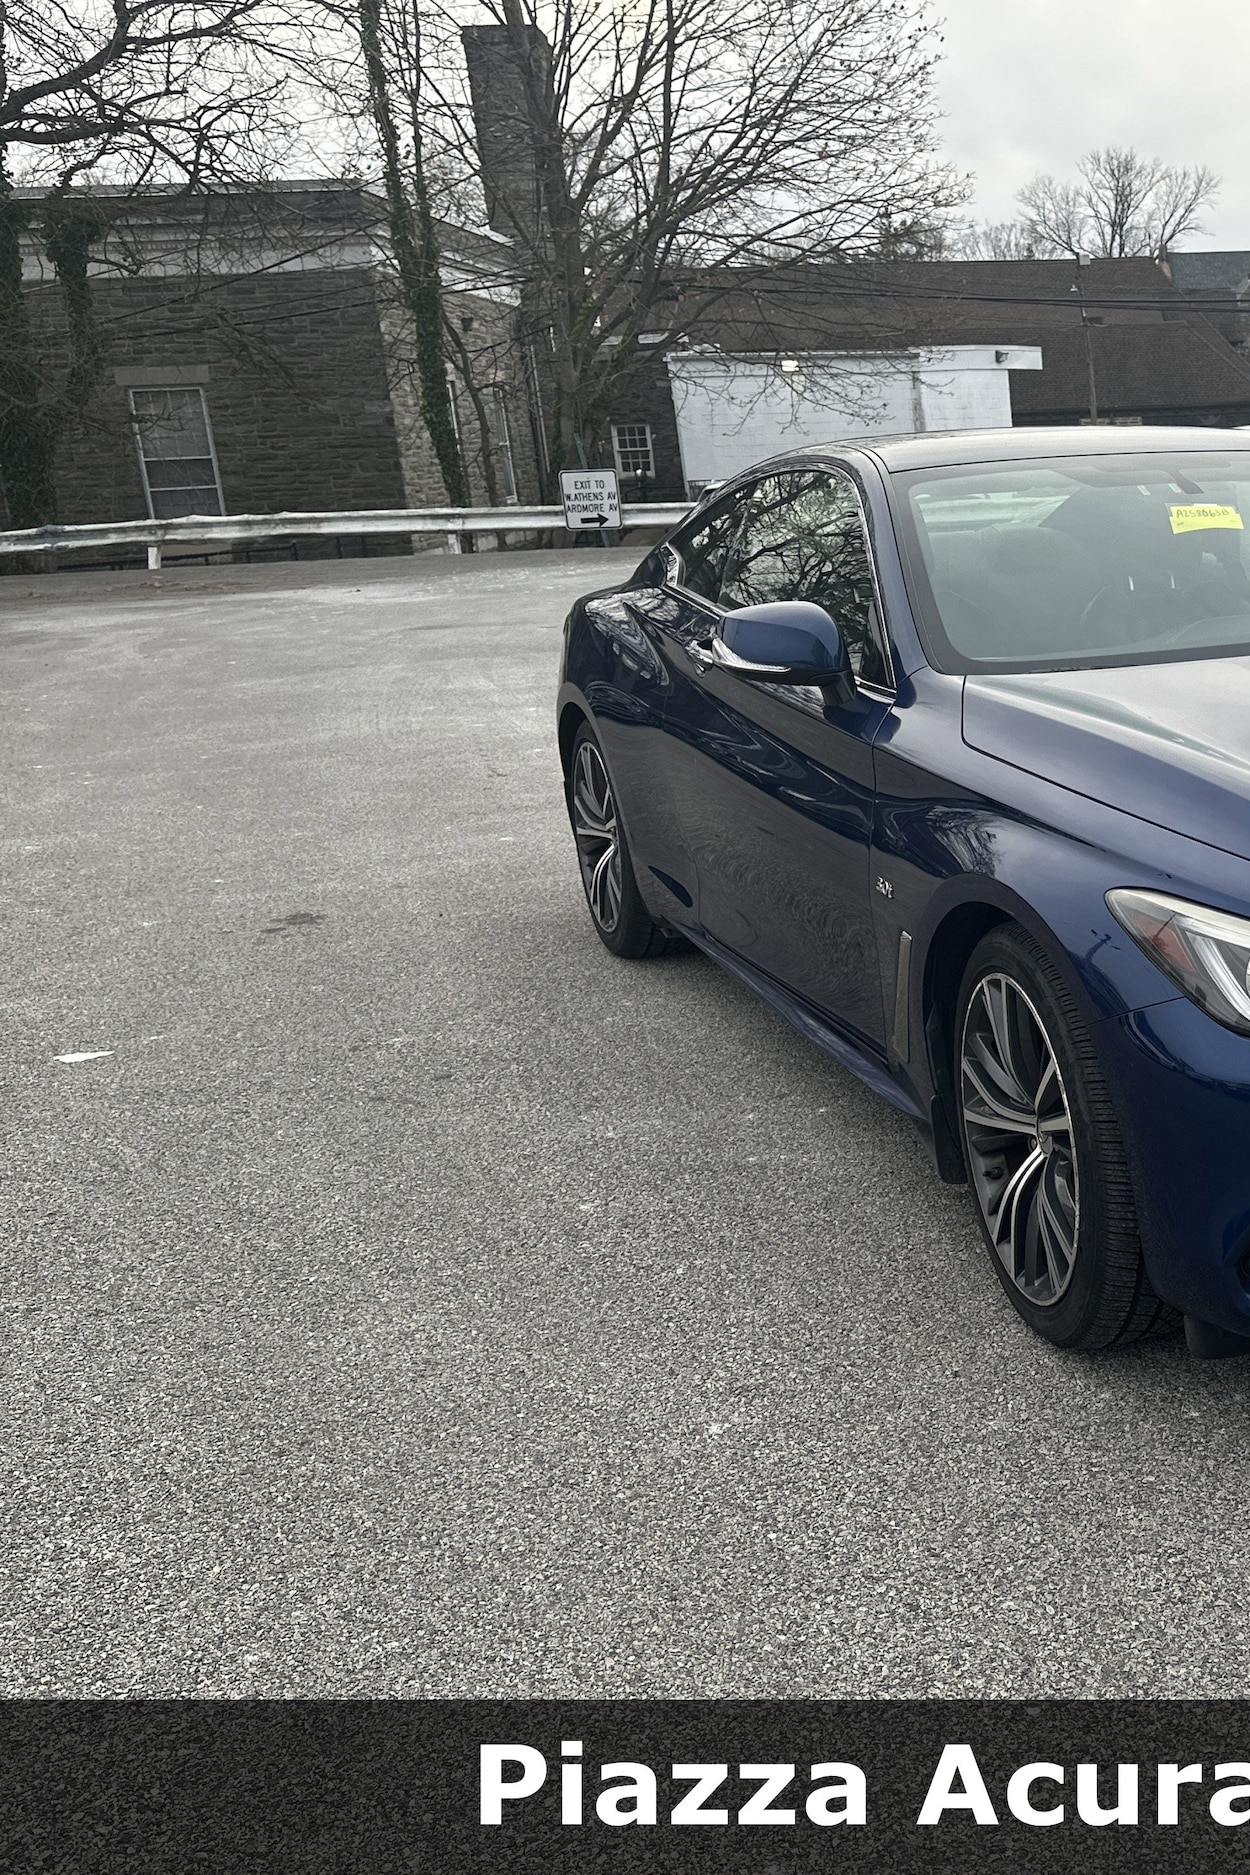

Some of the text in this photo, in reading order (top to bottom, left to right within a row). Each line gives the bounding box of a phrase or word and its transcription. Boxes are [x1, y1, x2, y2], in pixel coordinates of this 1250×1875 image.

[574, 480, 605, 489] EXIT TO
[607, 491, 616, 500] AV
[567, 503, 618, 513] ARDMORE AV
